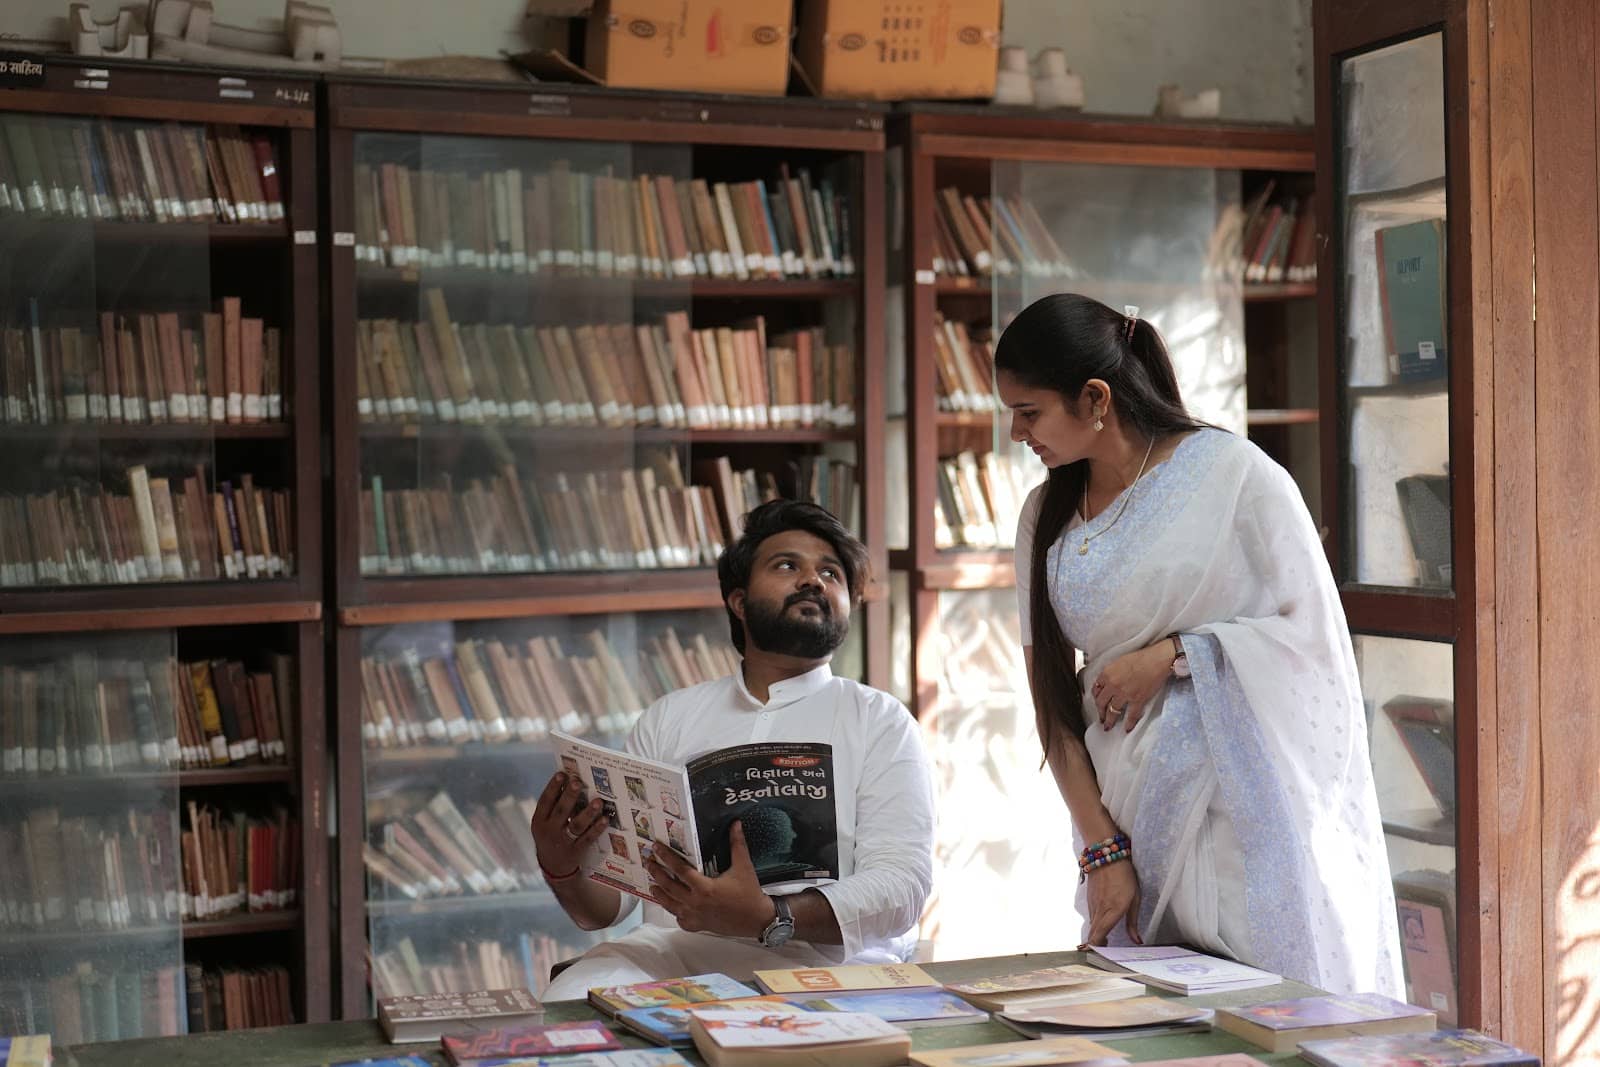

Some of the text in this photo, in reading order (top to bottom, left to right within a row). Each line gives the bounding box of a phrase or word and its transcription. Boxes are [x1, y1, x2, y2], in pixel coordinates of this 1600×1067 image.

[9, 60, 42, 75] साहित्य
[746, 767, 825, 780] વિજ્ઞાન અને
